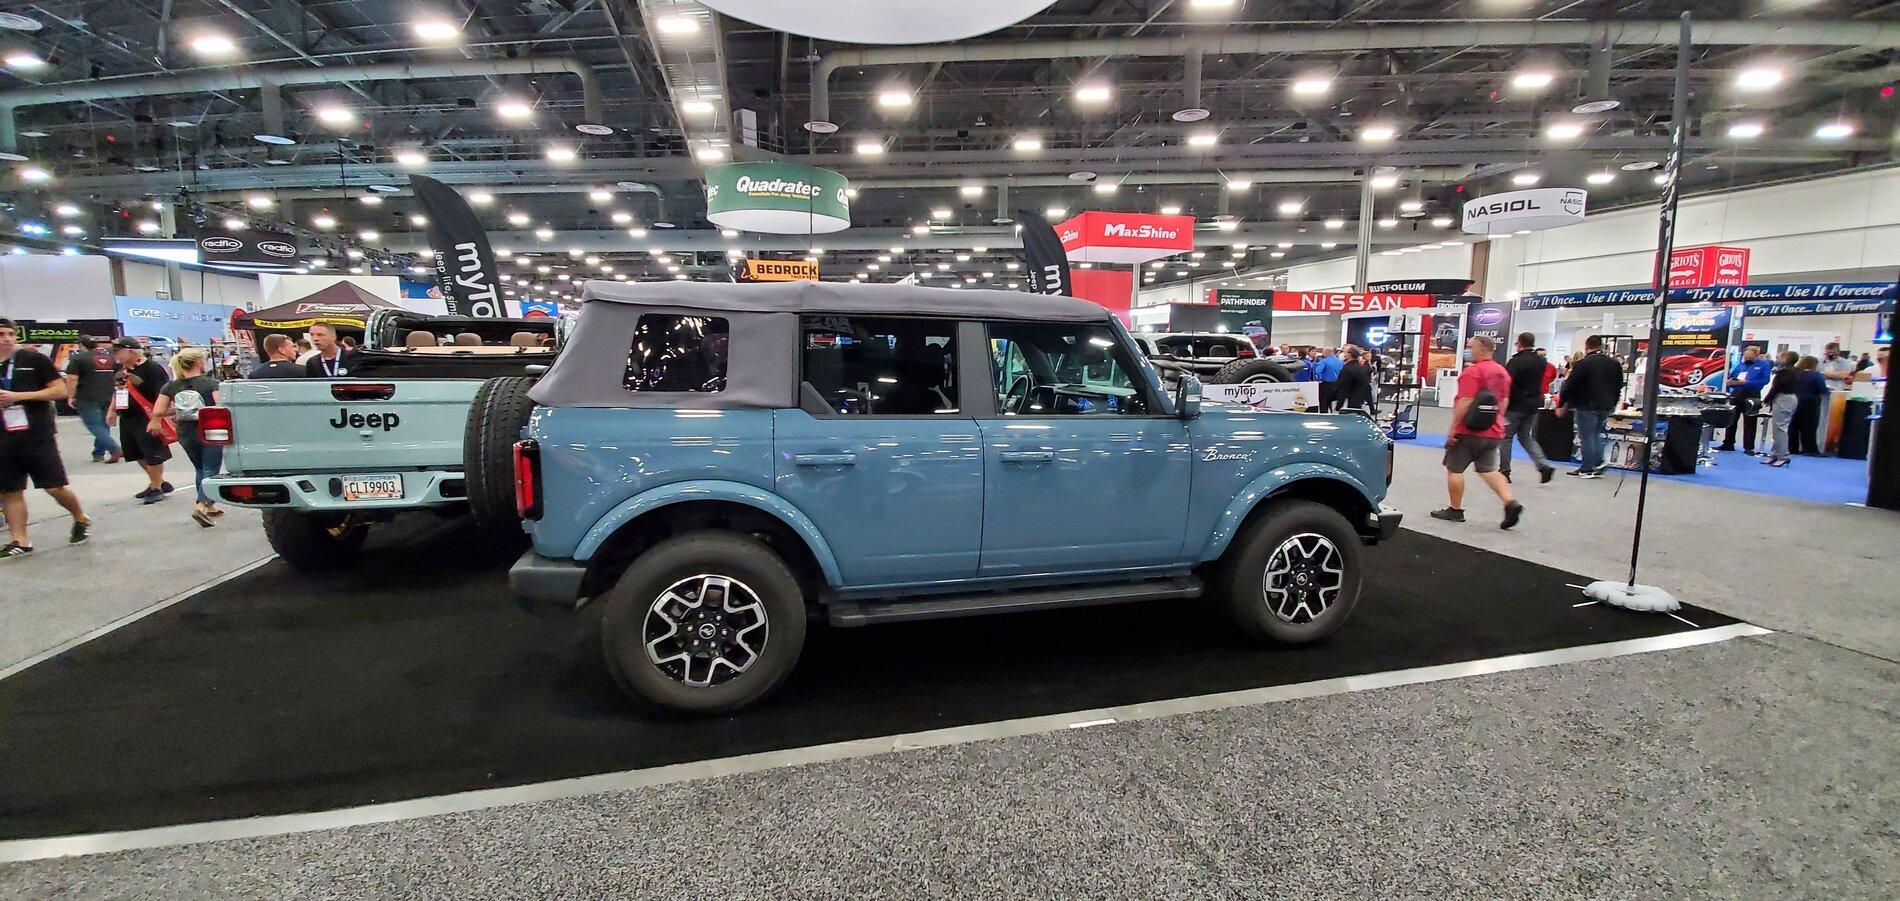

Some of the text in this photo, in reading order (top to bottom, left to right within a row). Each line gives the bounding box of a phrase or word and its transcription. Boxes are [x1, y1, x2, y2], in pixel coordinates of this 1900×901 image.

[736, 176, 822, 197] Quadratec
[1467, 199, 1541, 220] NASIOL
[1104, 223, 1177, 240] MaxShine
[204, 239, 238, 248] radflo
[263, 243, 294, 253] radflo
[434, 248, 446, 273] Jeep
[757, 264, 818, 276] BEDROCK
[1030, 269, 1038, 290] Jeep
[1669, 278, 1697, 287] ARAGE
[1368, 283, 1426, 293] RUST-OLEUM
[1717, 287, 1731, 299] It
[1732, 287, 1780, 299] Once...
[1785, 286, 1809, 297] Use
[1812, 285, 1827, 297] It
[1220, 298, 1267, 306] PATHFINDER
[1301, 293, 1402, 311] NISSAN
[1541, 296, 1549, 306] It
[1550, 295, 1583, 305] Once...
[1586, 294, 1606, 303] Use
[1606, 293, 1617, 302] It
[129, 308, 161, 319] GMC
[1770, 305, 1780, 313] It
[1781, 304, 1813, 313] Once...
[1815, 303, 1833, 312] Use
[1834, 303, 1843, 312] It
[1224, 385, 1256, 398] myTop
[330, 408, 399, 431] Jeep
[1201, 448, 1247, 462] Bronco
[349, 481, 395, 494] CLT9903
